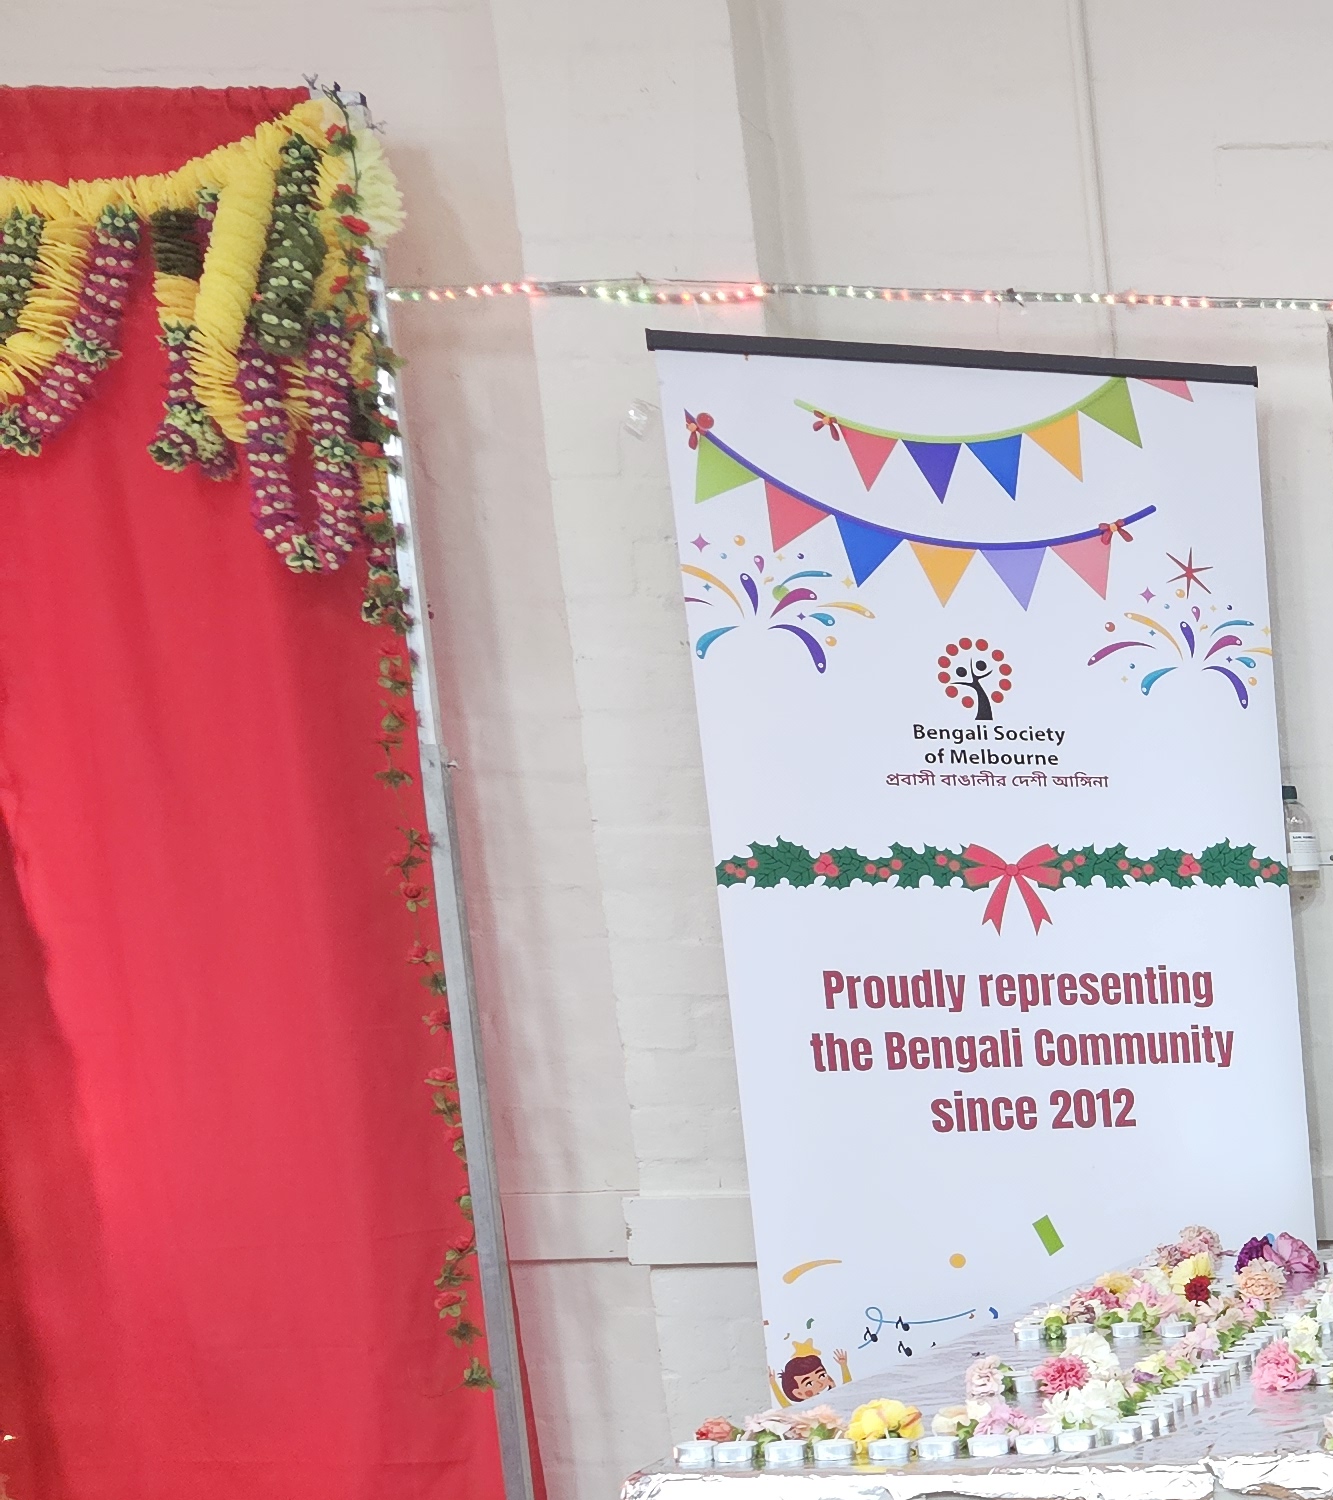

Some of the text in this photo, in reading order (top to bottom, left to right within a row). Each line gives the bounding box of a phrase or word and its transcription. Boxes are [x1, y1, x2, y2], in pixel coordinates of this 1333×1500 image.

[913, 724, 1066, 746] Bengali Society
[924, 748, 1059, 765] of Melbourne
[886, 770, 1108, 787] প্রবাসী বাঙালীর দেশী আঙ্গিনা
[823, 964, 1213, 1012] Proudly representing
[810, 1025, 1234, 1074] the Bengali Community
[931, 1088, 1136, 1132] since 2012
